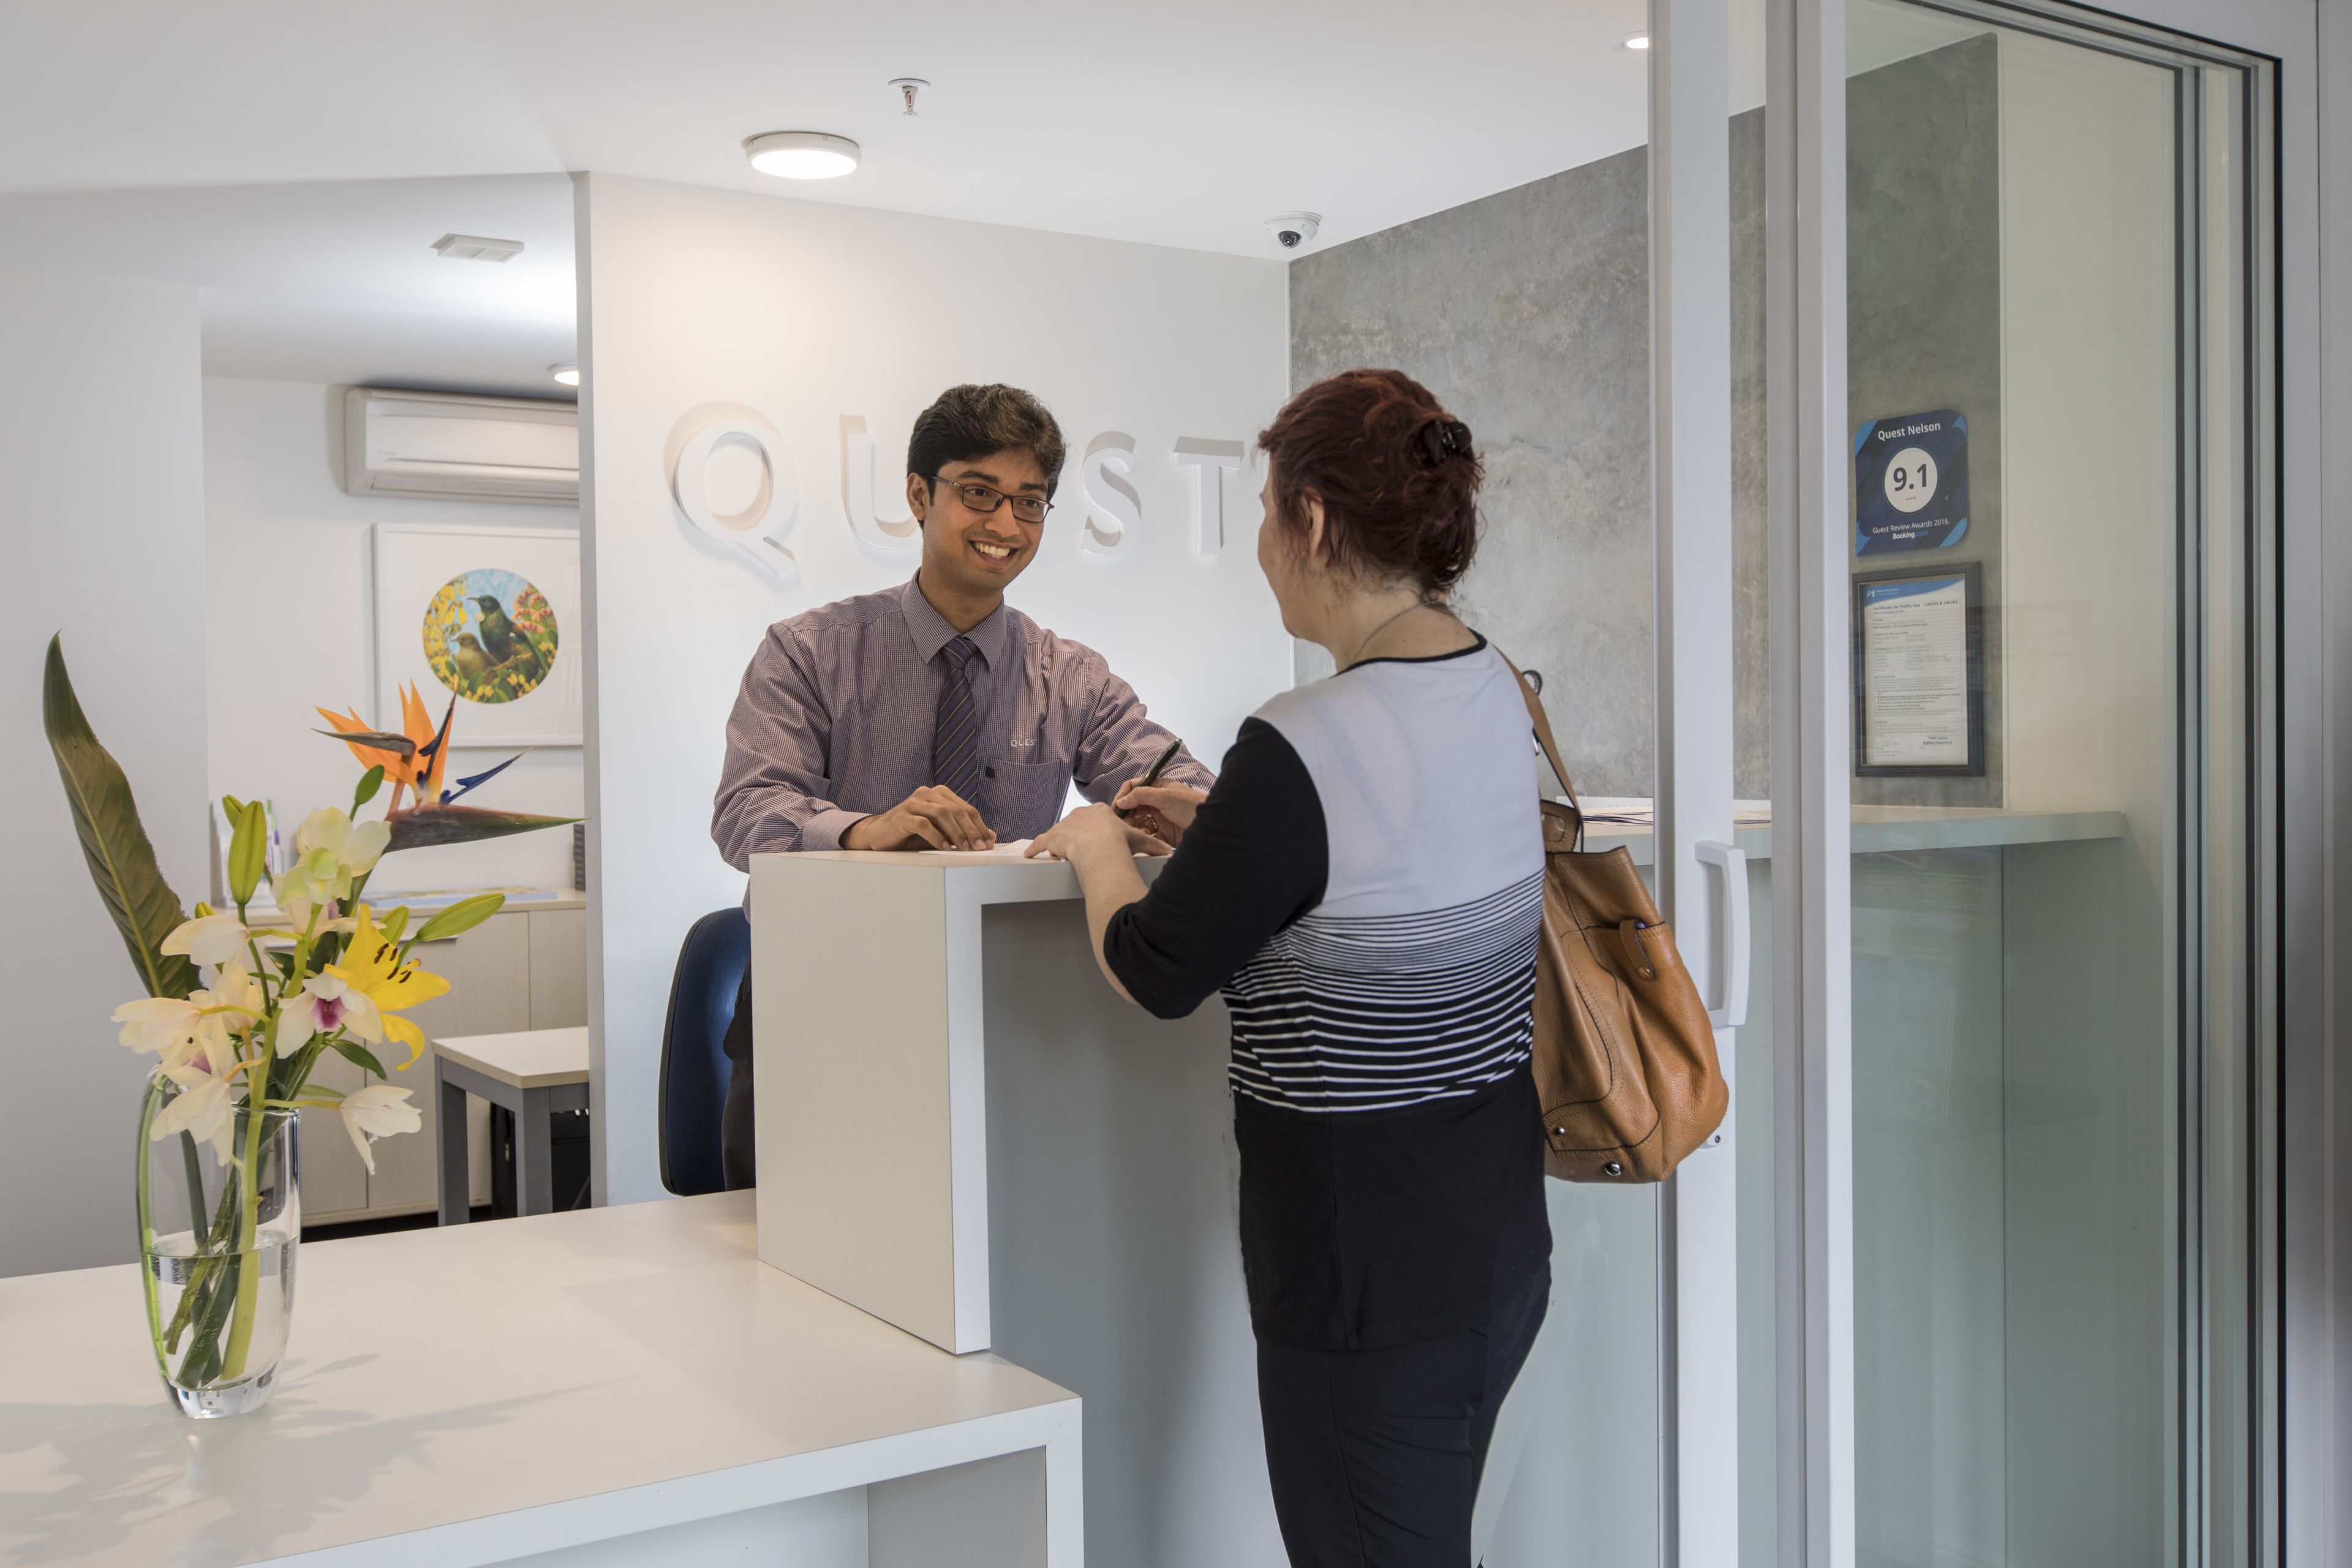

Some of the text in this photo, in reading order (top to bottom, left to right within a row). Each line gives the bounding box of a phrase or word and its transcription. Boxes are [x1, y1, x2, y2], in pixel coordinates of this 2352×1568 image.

[1878, 423, 1940, 441] Quest Nelson
[1893, 464, 1926, 492] 9.1
[663, 400, 1245, 578] QUST
[1911, 520, 1932, 529] Awards
[1893, 530, 1928, 540] Booking.com
[1011, 739, 1037, 747] QUES
